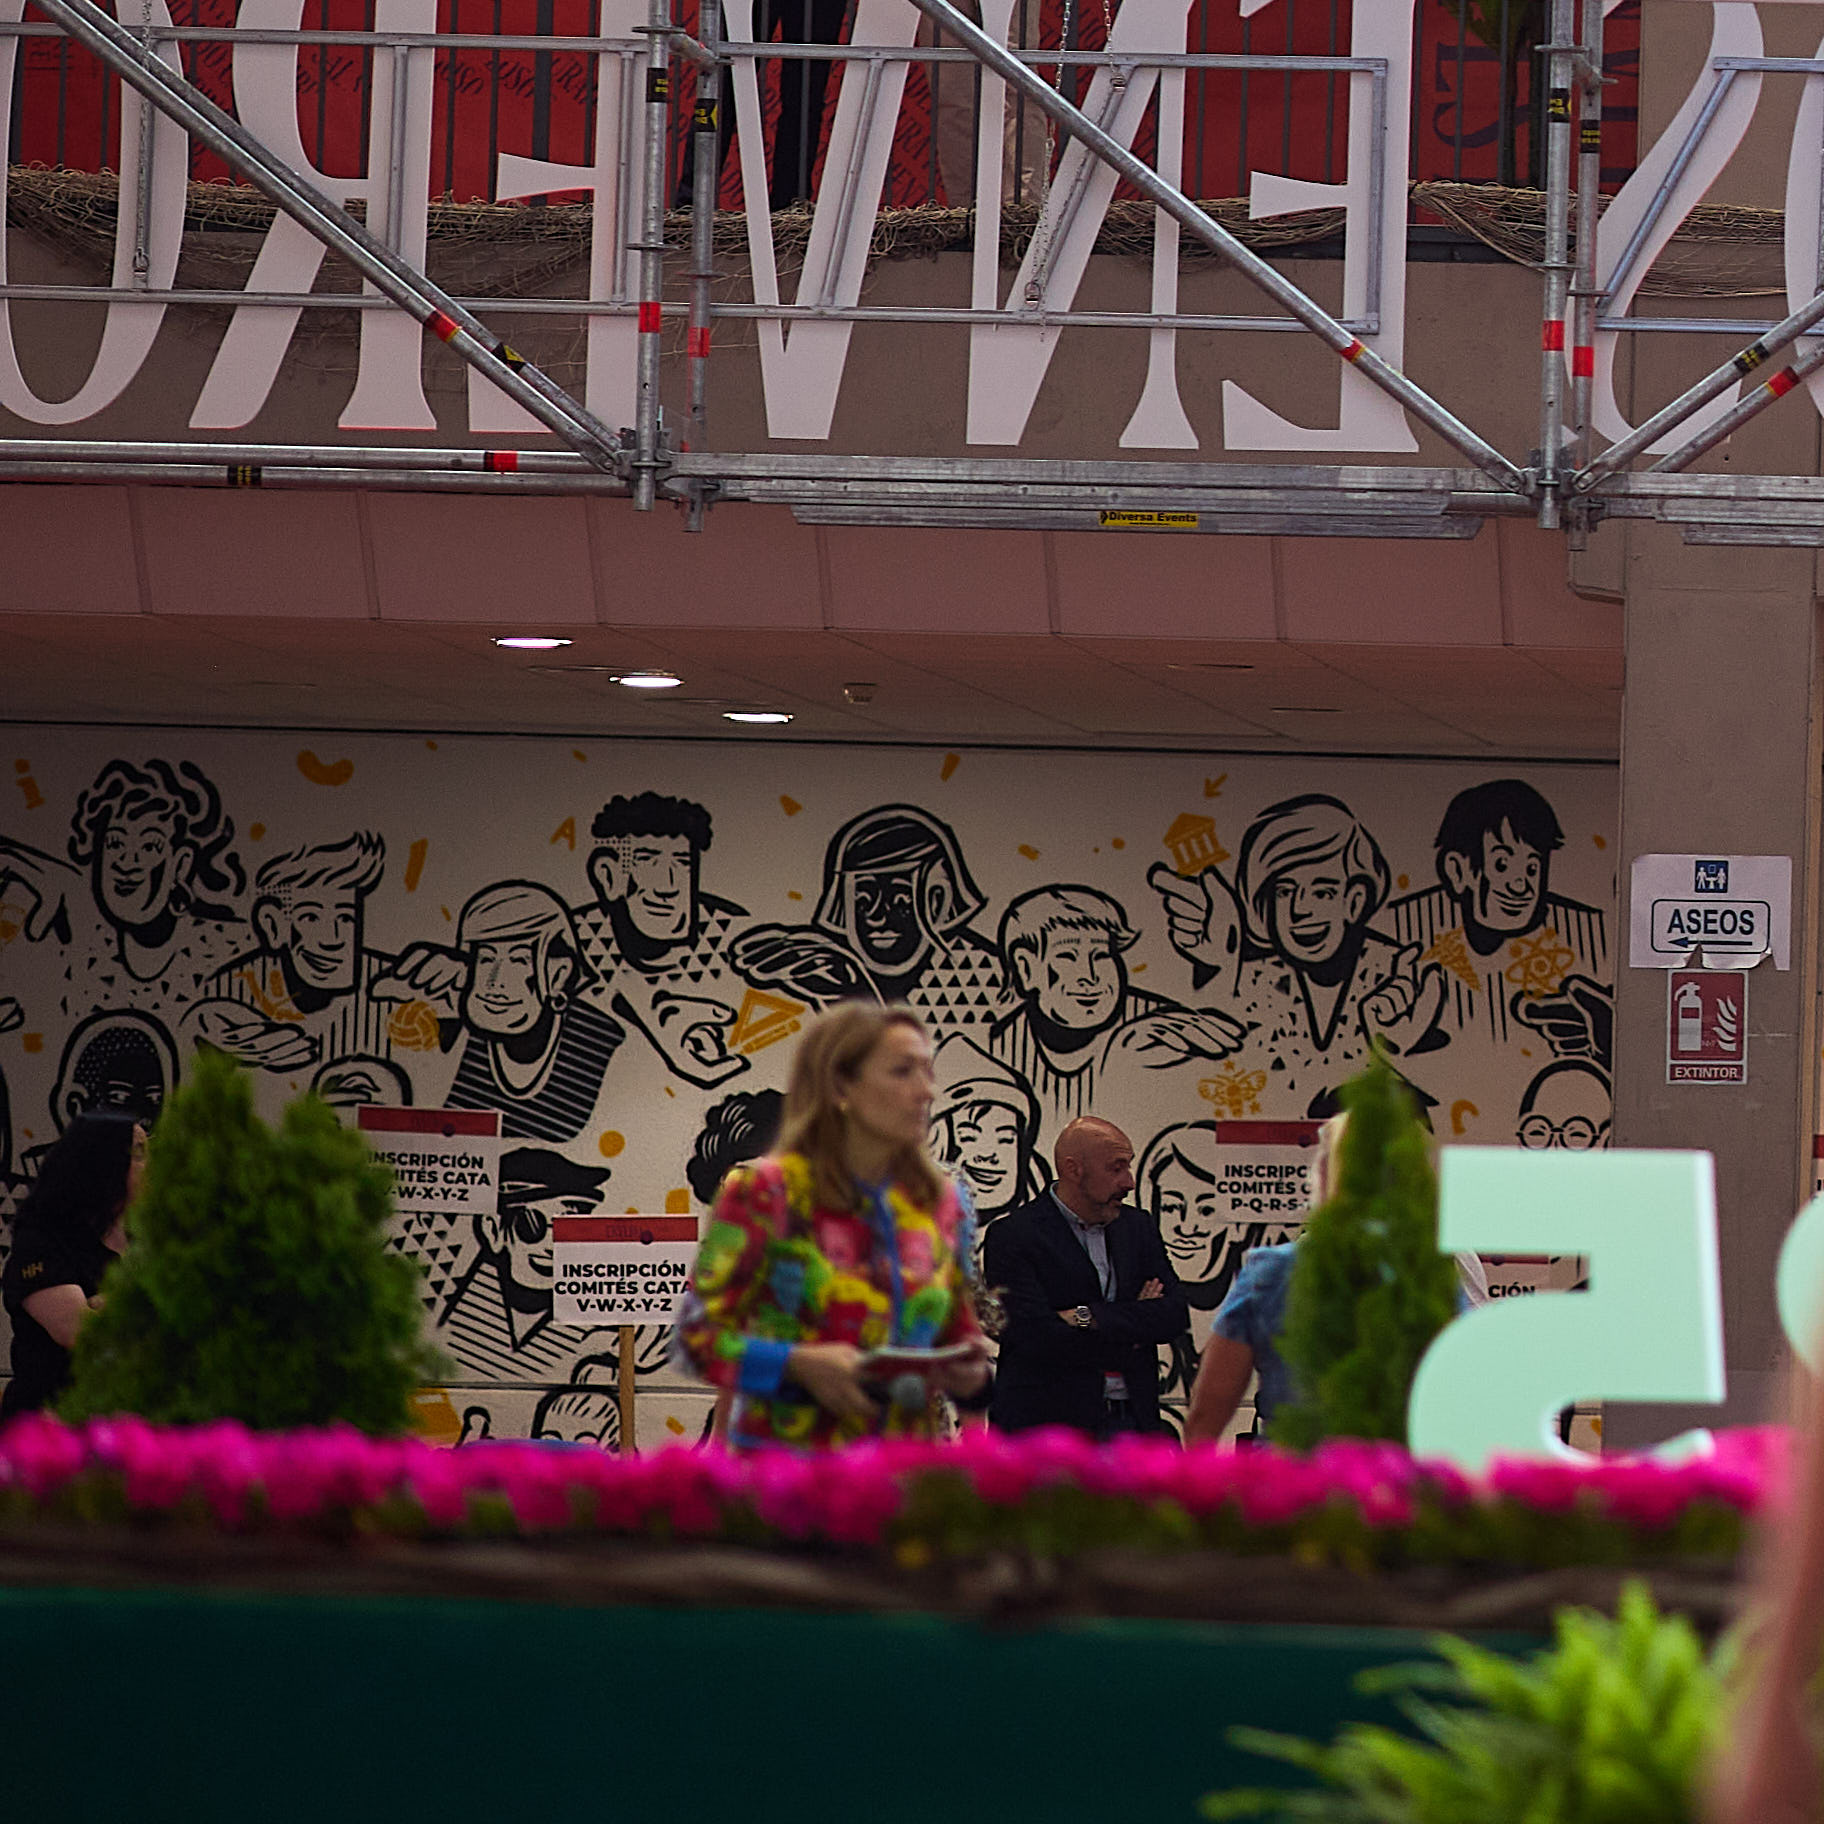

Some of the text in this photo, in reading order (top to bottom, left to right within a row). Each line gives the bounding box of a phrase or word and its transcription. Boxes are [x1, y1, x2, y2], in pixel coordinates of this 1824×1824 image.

[1109, 512, 1197, 522] Diversa Events
[1667, 908, 1754, 935] ASEOS
[1675, 1064, 1738, 1079] EXTINTOR
[1225, 1164, 1307, 1178] INSCRIPC
[443, 1172, 491, 1186] CATA
[1216, 1178, 1297, 1194] COMITÉS
[562, 1259, 686, 1277] INSCRIPCIÓN
[554, 1278, 639, 1295] COMITÉS
[576, 1298, 673, 1312] V-W-X-Y-Z
